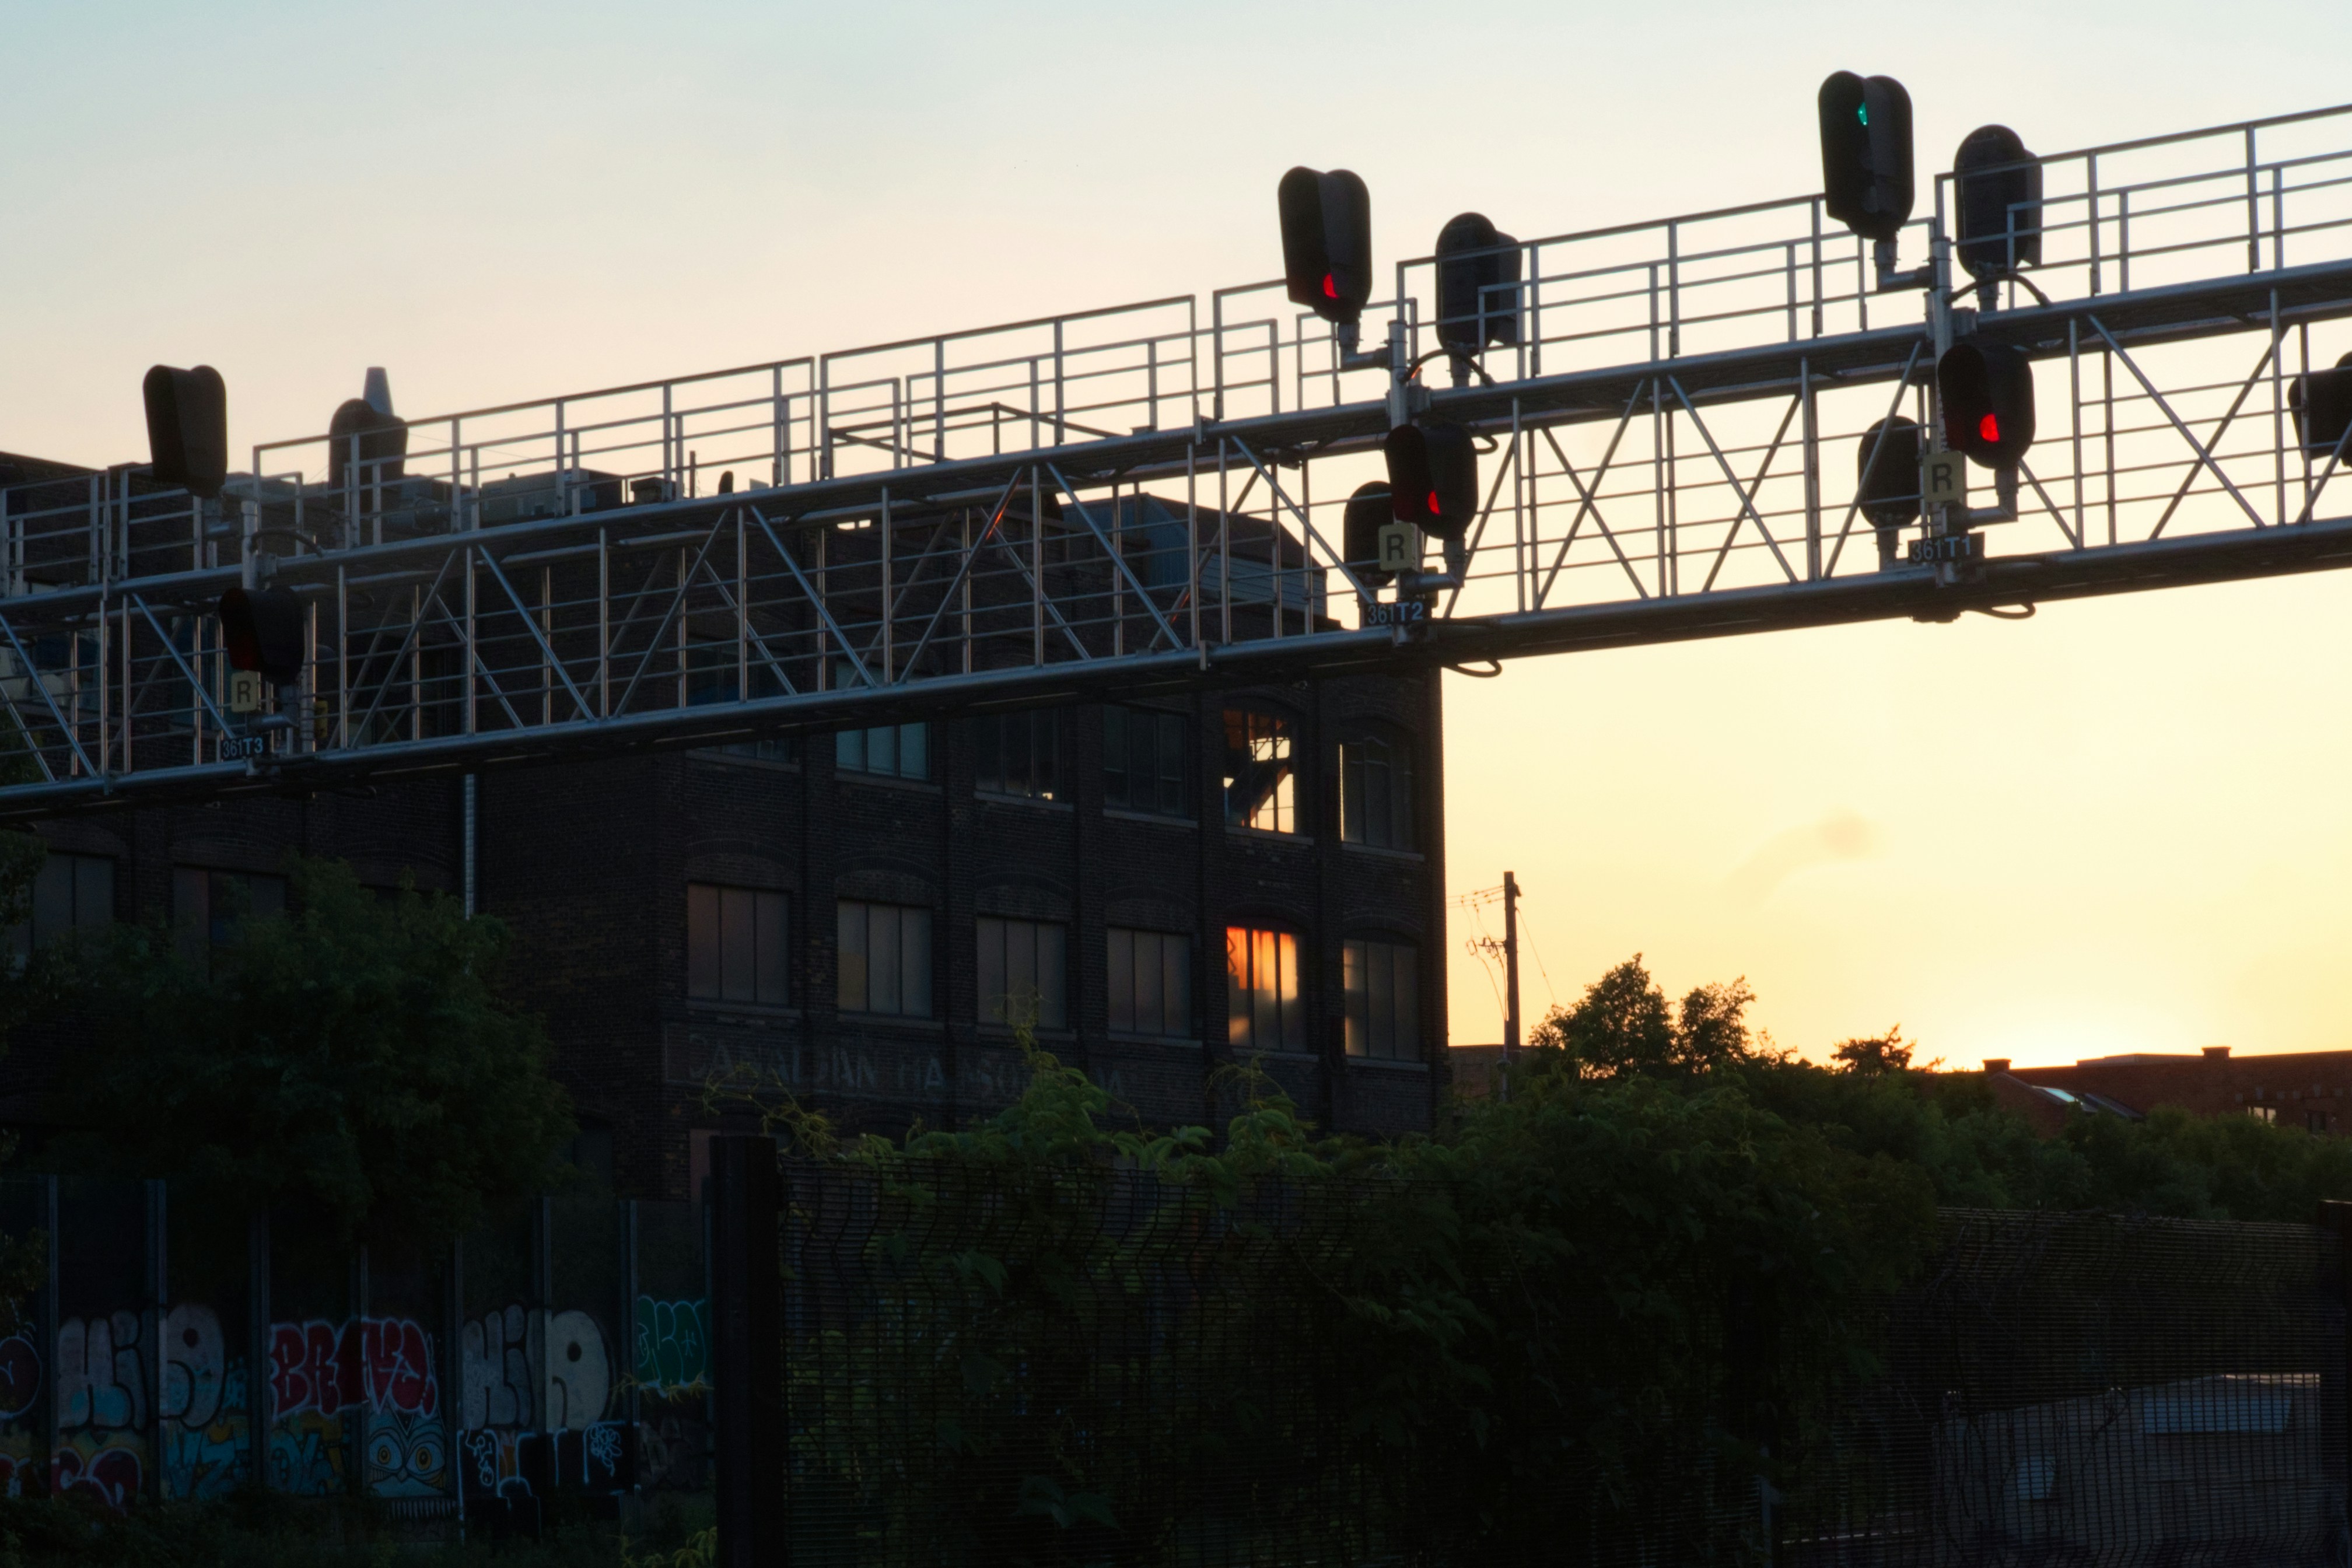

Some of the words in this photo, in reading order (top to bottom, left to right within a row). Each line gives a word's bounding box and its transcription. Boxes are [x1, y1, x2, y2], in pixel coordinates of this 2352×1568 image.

[1932, 463, 1952, 493] R
[1386, 533, 1405, 562] R
[1912, 536, 1971, 562] 361T1
[1368, 601, 1424, 625] 361T2
[236, 680, 251, 704] R
[222, 737, 264, 758] 361T3
